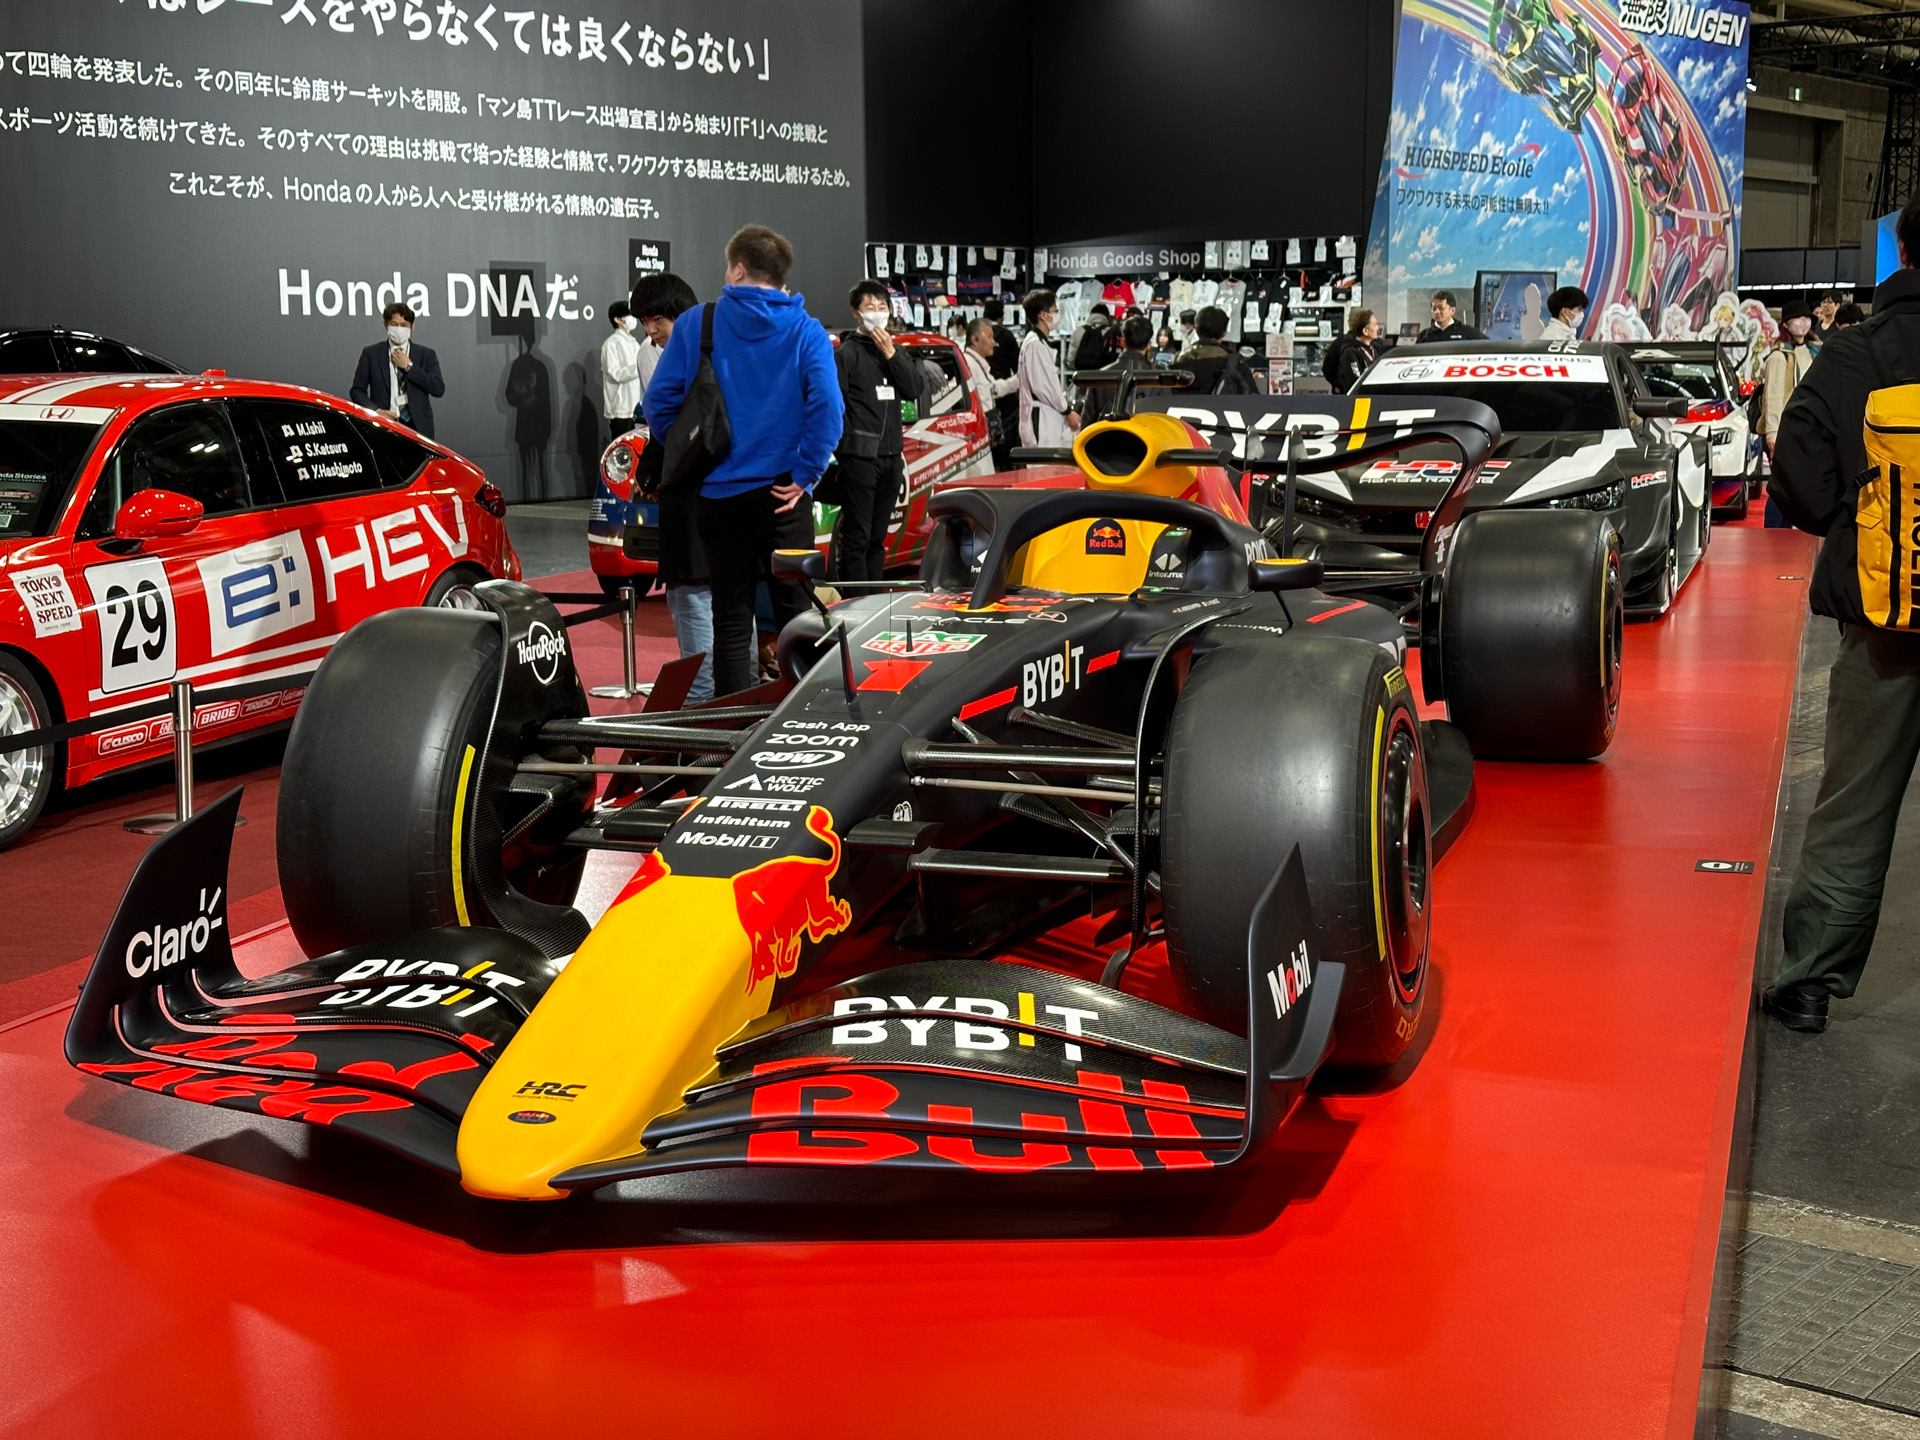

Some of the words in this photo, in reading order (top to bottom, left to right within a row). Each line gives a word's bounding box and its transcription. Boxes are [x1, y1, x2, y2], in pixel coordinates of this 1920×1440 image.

[1668, 3, 1747, 48] MUGEN
[1403, 146, 1489, 176] HIGHSPEED
[1490, 156, 1534, 178] Etoile
[642, 244, 659, 257] Honda
[1050, 252, 1098, 269] Honda
[1102, 250, 1154, 268] Goods
[1158, 248, 1201, 269] Shop
[278, 268, 430, 317] Honda
[1442, 365, 1570, 378] BOSCH
[296, 420, 326, 436] M.Ishii
[305, 442, 348, 457] S.Katsura
[14, 472, 47, 480] Stories
[311, 461, 363, 479] Y.Hashimoto
[316, 494, 469, 603] HEV
[1089, 538, 1107, 549] Red
[1107, 539, 1123, 549] Bull
[30, 590, 65, 608] NEXT
[36, 605, 73, 625] SPEED
[890, 615, 1030, 625] ORACLE
[106, 580, 167, 668] 29
[887, 632, 976, 643] TAG
[868, 641, 968, 655] HEUER
[1022, 640, 1084, 709] BYBIT
[201, 707, 236, 725] BRIDE
[782, 720, 829, 730] Cash
[830, 721, 871, 732] App
[111, 732, 145, 747] CUSCO
[763, 775, 825, 786] ARCTIC
[766, 784, 815, 793] WOLF
[707, 795, 808, 812] PIRELLI
[675, 831, 751, 848] Mobil
[125, 917, 211, 979] Claro
[1267, 939, 1312, 1020] Mobil
[832, 992, 1100, 1061] BYBIT
[515, 1081, 588, 1098] HRC
[747, 1056, 1215, 1172] Bull
